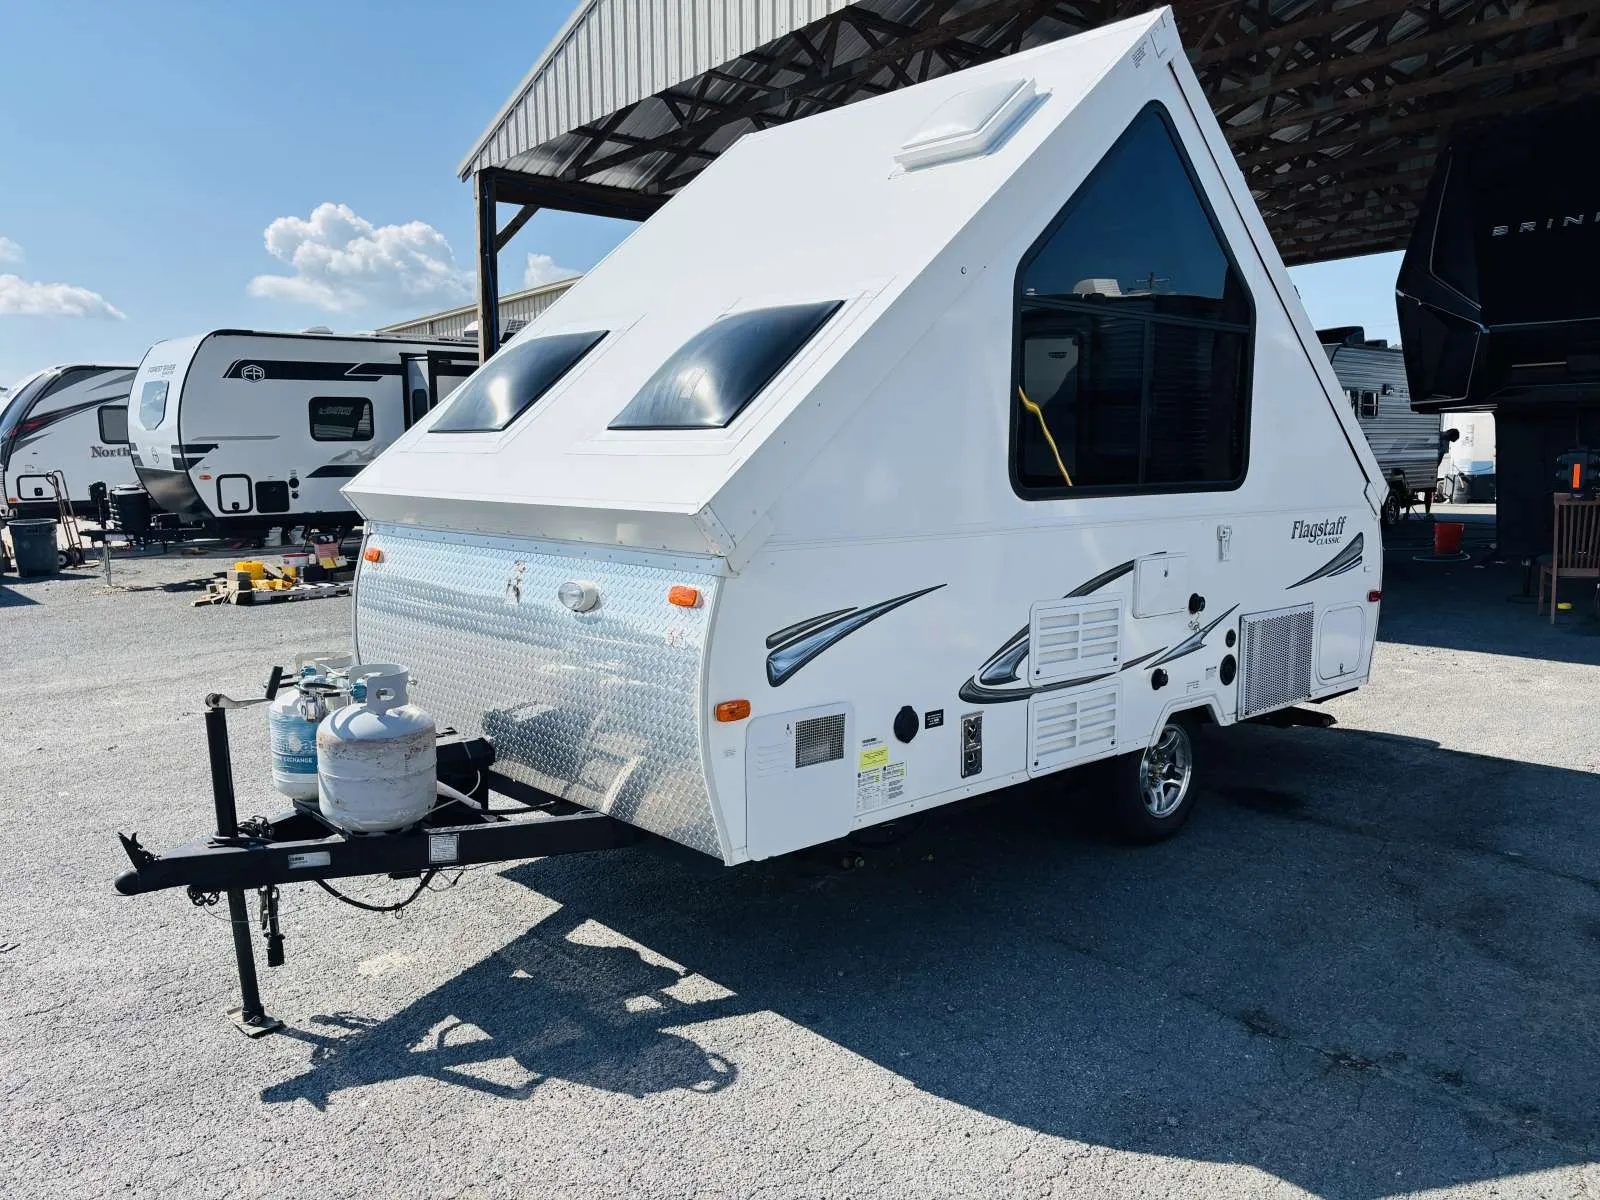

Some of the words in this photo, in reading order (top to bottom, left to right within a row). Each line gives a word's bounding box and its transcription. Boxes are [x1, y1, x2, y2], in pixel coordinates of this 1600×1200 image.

[90, 446, 131, 458] North
[1291, 515, 1347, 543] Flagstaff
[1316, 536, 1341, 545] CLASSIC
